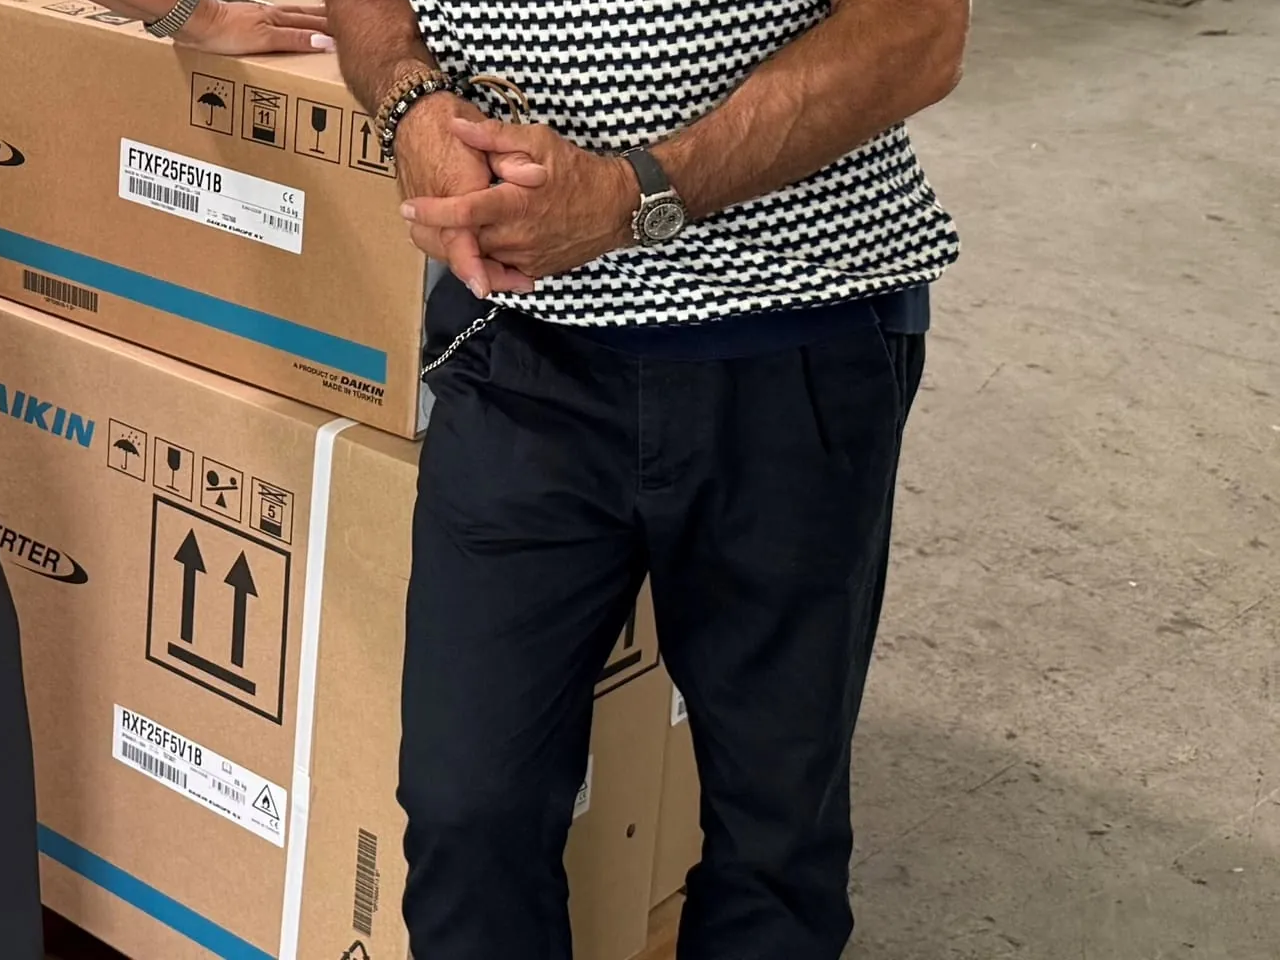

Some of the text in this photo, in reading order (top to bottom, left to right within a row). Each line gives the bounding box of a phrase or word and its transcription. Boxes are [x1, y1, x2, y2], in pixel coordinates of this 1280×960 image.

[128, 147, 223, 194] FTXF25F5V1B
[298, 363, 329, 378] PRODUCT
[329, 373, 338, 382] OF
[340, 375, 385, 398] DAIKIN
[322, 379, 343, 393] MADE
[122, 710, 203, 767] RXF25F5V1B
